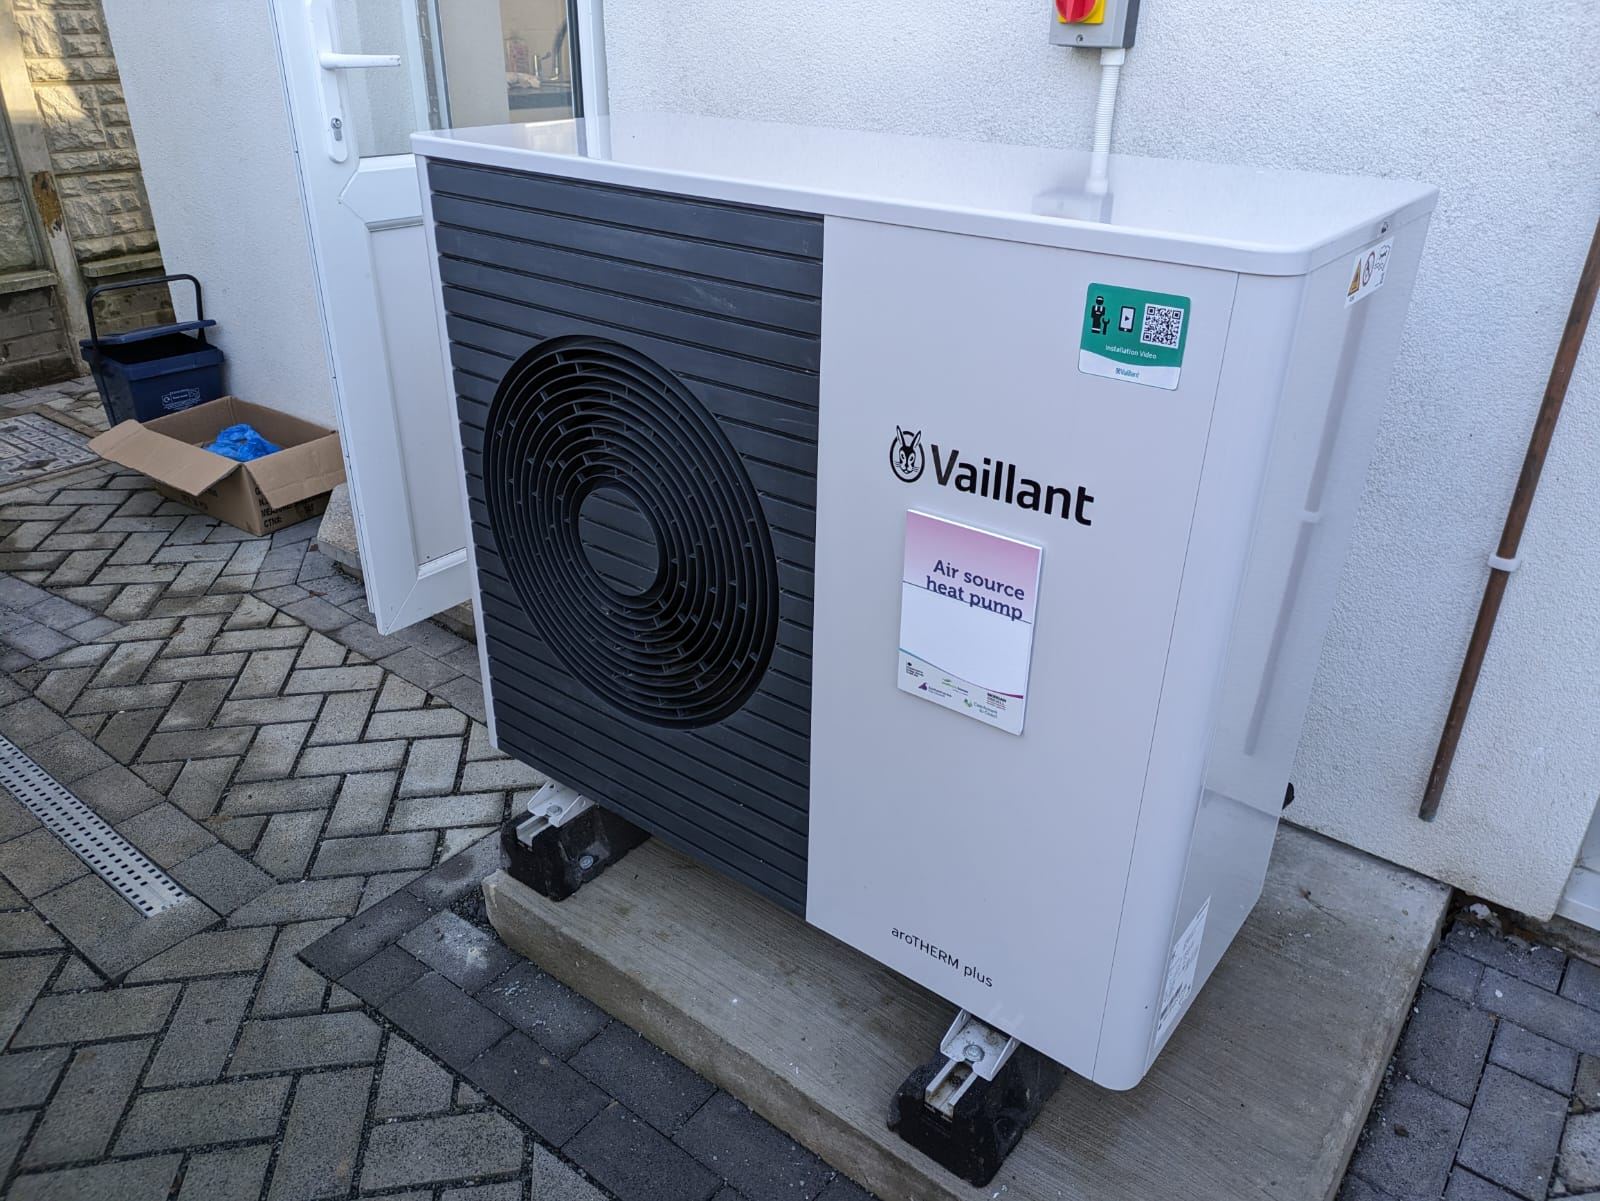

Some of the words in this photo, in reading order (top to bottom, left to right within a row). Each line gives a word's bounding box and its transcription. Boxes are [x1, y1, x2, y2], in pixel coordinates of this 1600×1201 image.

[1105, 344, 1139, 356] Installation
[1140, 350, 1157, 359] Video
[930, 443, 1095, 526] Vaillant
[926, 575, 965, 601] heat
[969, 592, 1023, 621] pump
[933, 559, 959, 579] Air
[963, 571, 1025, 601] source
[891, 927, 959, 970] aroTHERM
[963, 966, 993, 987] plus
